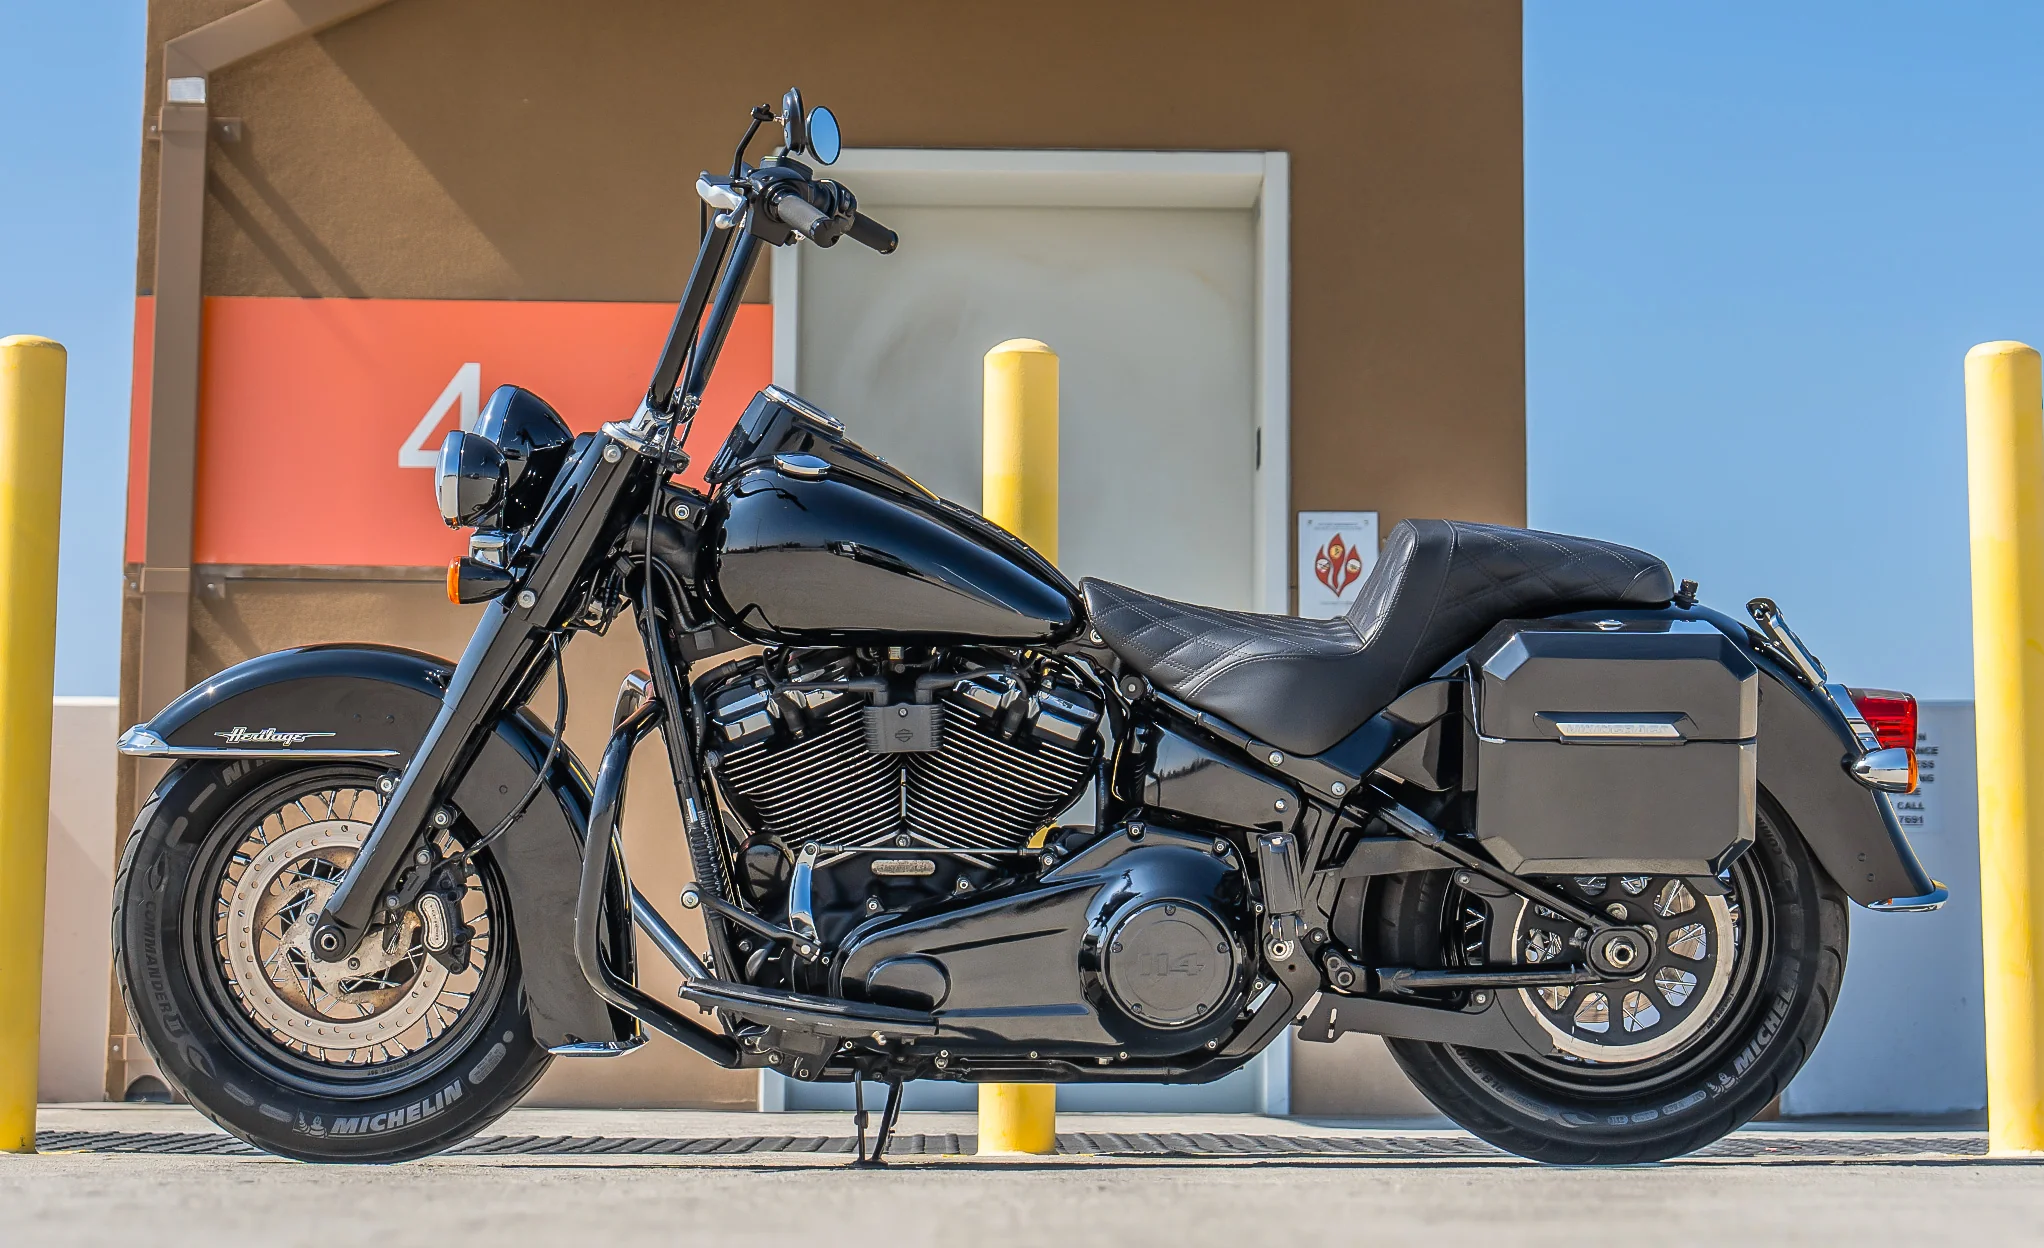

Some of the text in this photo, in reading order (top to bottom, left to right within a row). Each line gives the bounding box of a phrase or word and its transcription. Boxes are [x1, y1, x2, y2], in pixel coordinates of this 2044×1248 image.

[398, 362, 481, 468] 4
[225, 726, 307, 746] Heritage
[144, 900, 172, 1014] COMMANDER
[1138, 952, 1205, 976] 114
[330, 1079, 463, 1134] MICHELIN
